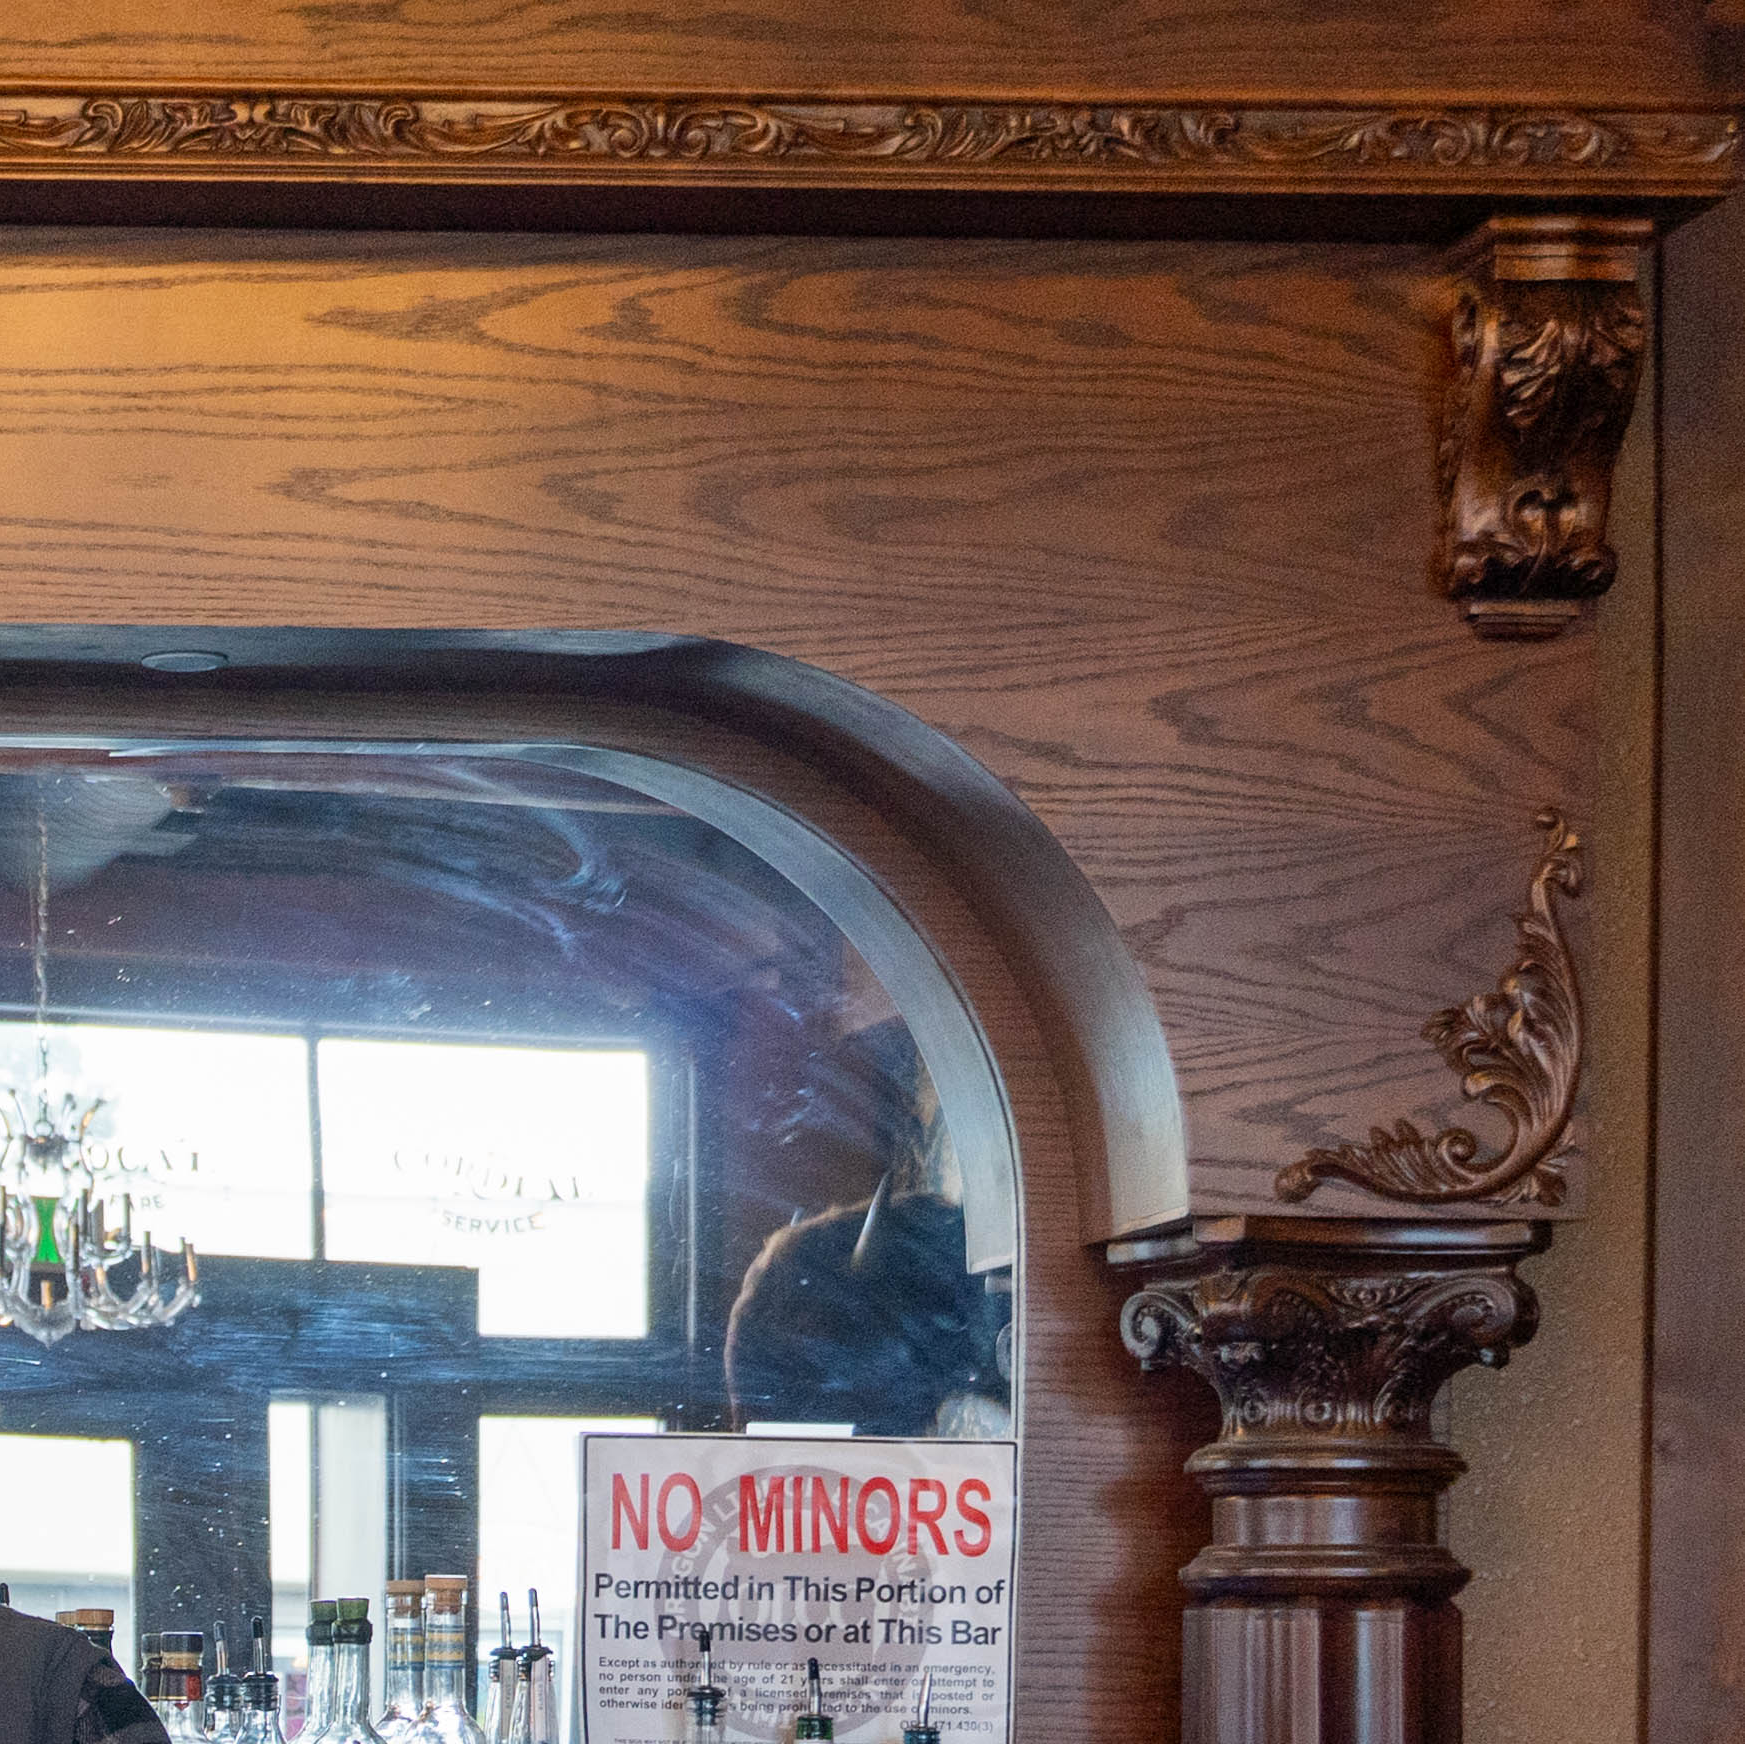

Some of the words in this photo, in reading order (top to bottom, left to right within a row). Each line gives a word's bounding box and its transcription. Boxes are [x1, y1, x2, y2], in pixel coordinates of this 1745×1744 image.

[612, 1472, 703, 1552] NO
[738, 1475, 992, 1558] MINORS
[594, 1573, 739, 1600] Permitted
[748, 1576, 774, 1601] in
[783, 1576, 847, 1602] This
[855, 1577, 966, 1604] Portion
[975, 1579, 1005, 1604] of
[594, 1613, 649, 1639] The
[658, 1615, 797, 1642] Premises
[804, 1623, 837, 1644] or
[843, 1619, 871, 1643] at
[878, 1619, 942, 1644] This
[951, 1620, 1002, 1645] Bar
[599, 1656, 640, 1670] Except
[643, 1660, 657, 1668] as
[660, 1658, 726, 1670] authored
[729, 1660, 744, 1672] by
[792, 1663, 806, 1671] as
[810, 1661, 886, 1672] ecessitated
[890, 1664, 901, 1672] in
[599, 1673, 614, 1681] no
[619, 1675, 661, 1685] person
[733, 1677, 756, 1685] age
[762, 1674, 774, 1684] of
[780, 1675, 794, 1684] 21
[840, 1675, 869, 1685] shall
[874, 1678, 906, 1686] enter
[982, 1678, 995, 1687] to
[599, 1687, 630, 1695] enter
[637, 1689, 659, 1697] any
[755, 1687, 807, 1698] licensed
[880, 1691, 904, 1700] that
[931, 1692, 973, 1703] posted
[599, 1699, 657, 1710] otherwise
[740, 1701, 775, 1713] being
[845, 1704, 857, 1713] to
[861, 1704, 881, 1713] the
[927, 1706, 972, 1715] minors.
